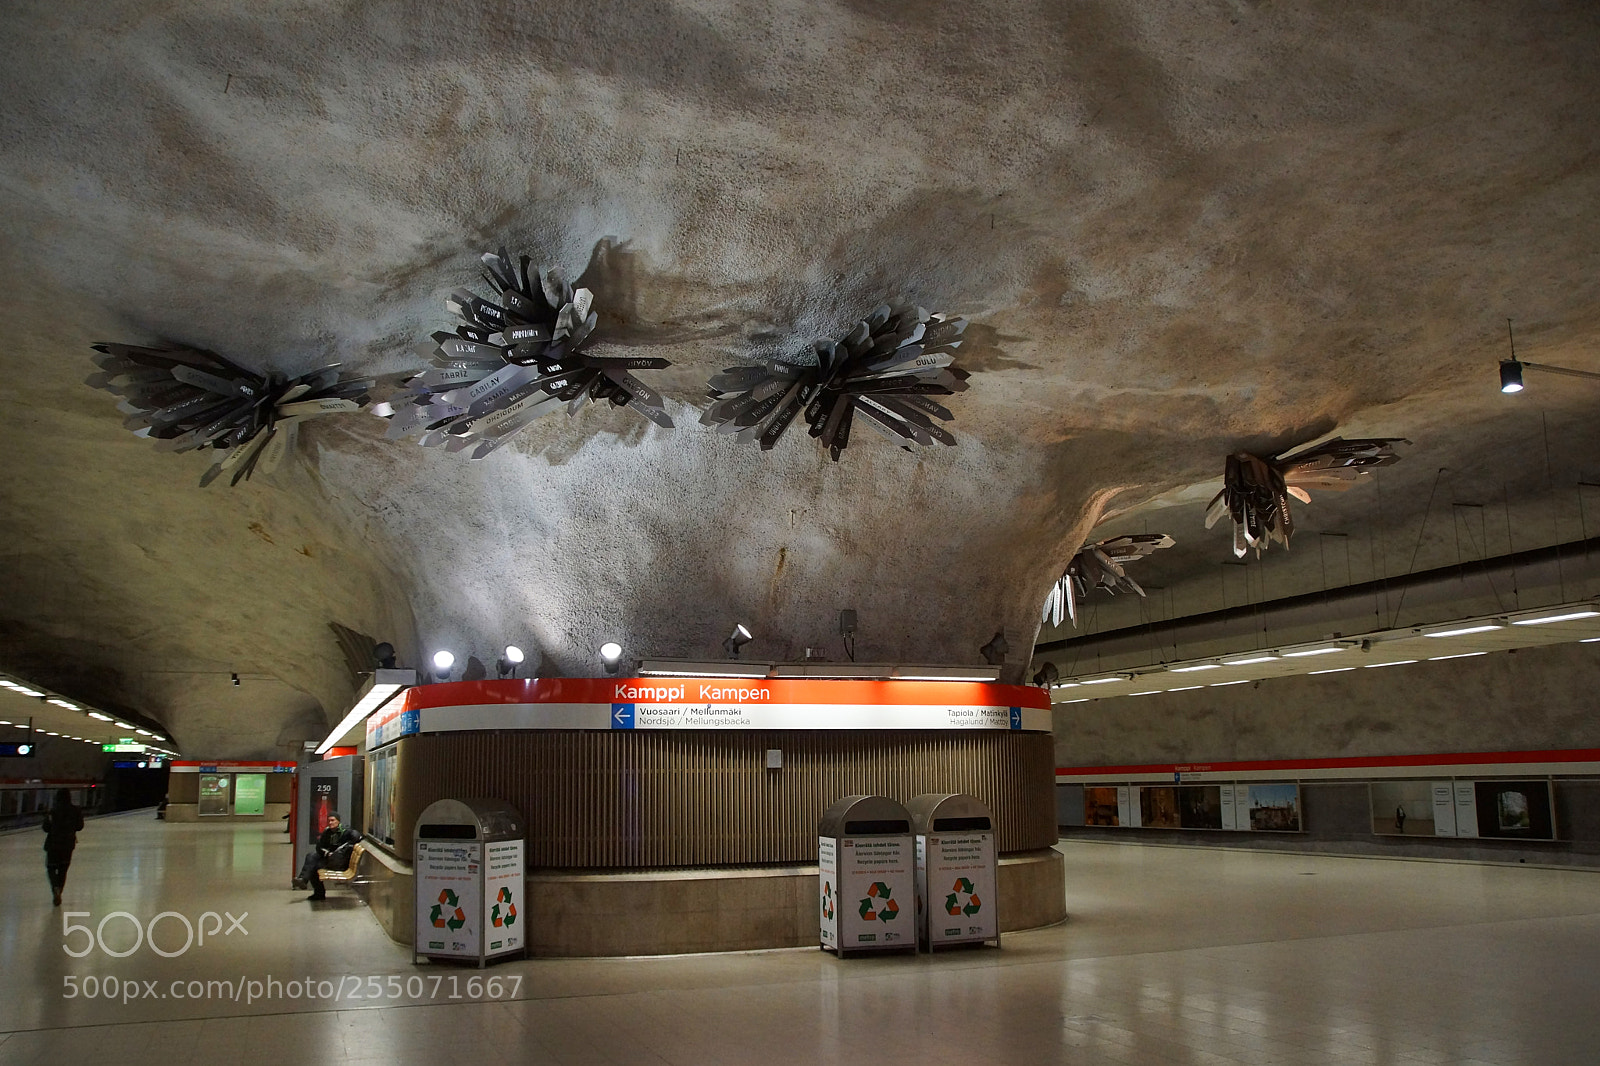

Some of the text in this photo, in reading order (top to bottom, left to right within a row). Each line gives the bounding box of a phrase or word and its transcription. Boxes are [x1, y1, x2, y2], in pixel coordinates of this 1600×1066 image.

[614, 684, 770, 702] Kamppi Kampen
[640, 708, 680, 716] Vuosaari
[690, 707, 741, 716] Mellunmäki
[948, 710, 974, 718] Tapiola
[639, 717, 675, 726] Nordsjö
[686, 717, 751, 726] Mellungsbacka
[950, 718, 984, 726] Hagalund
